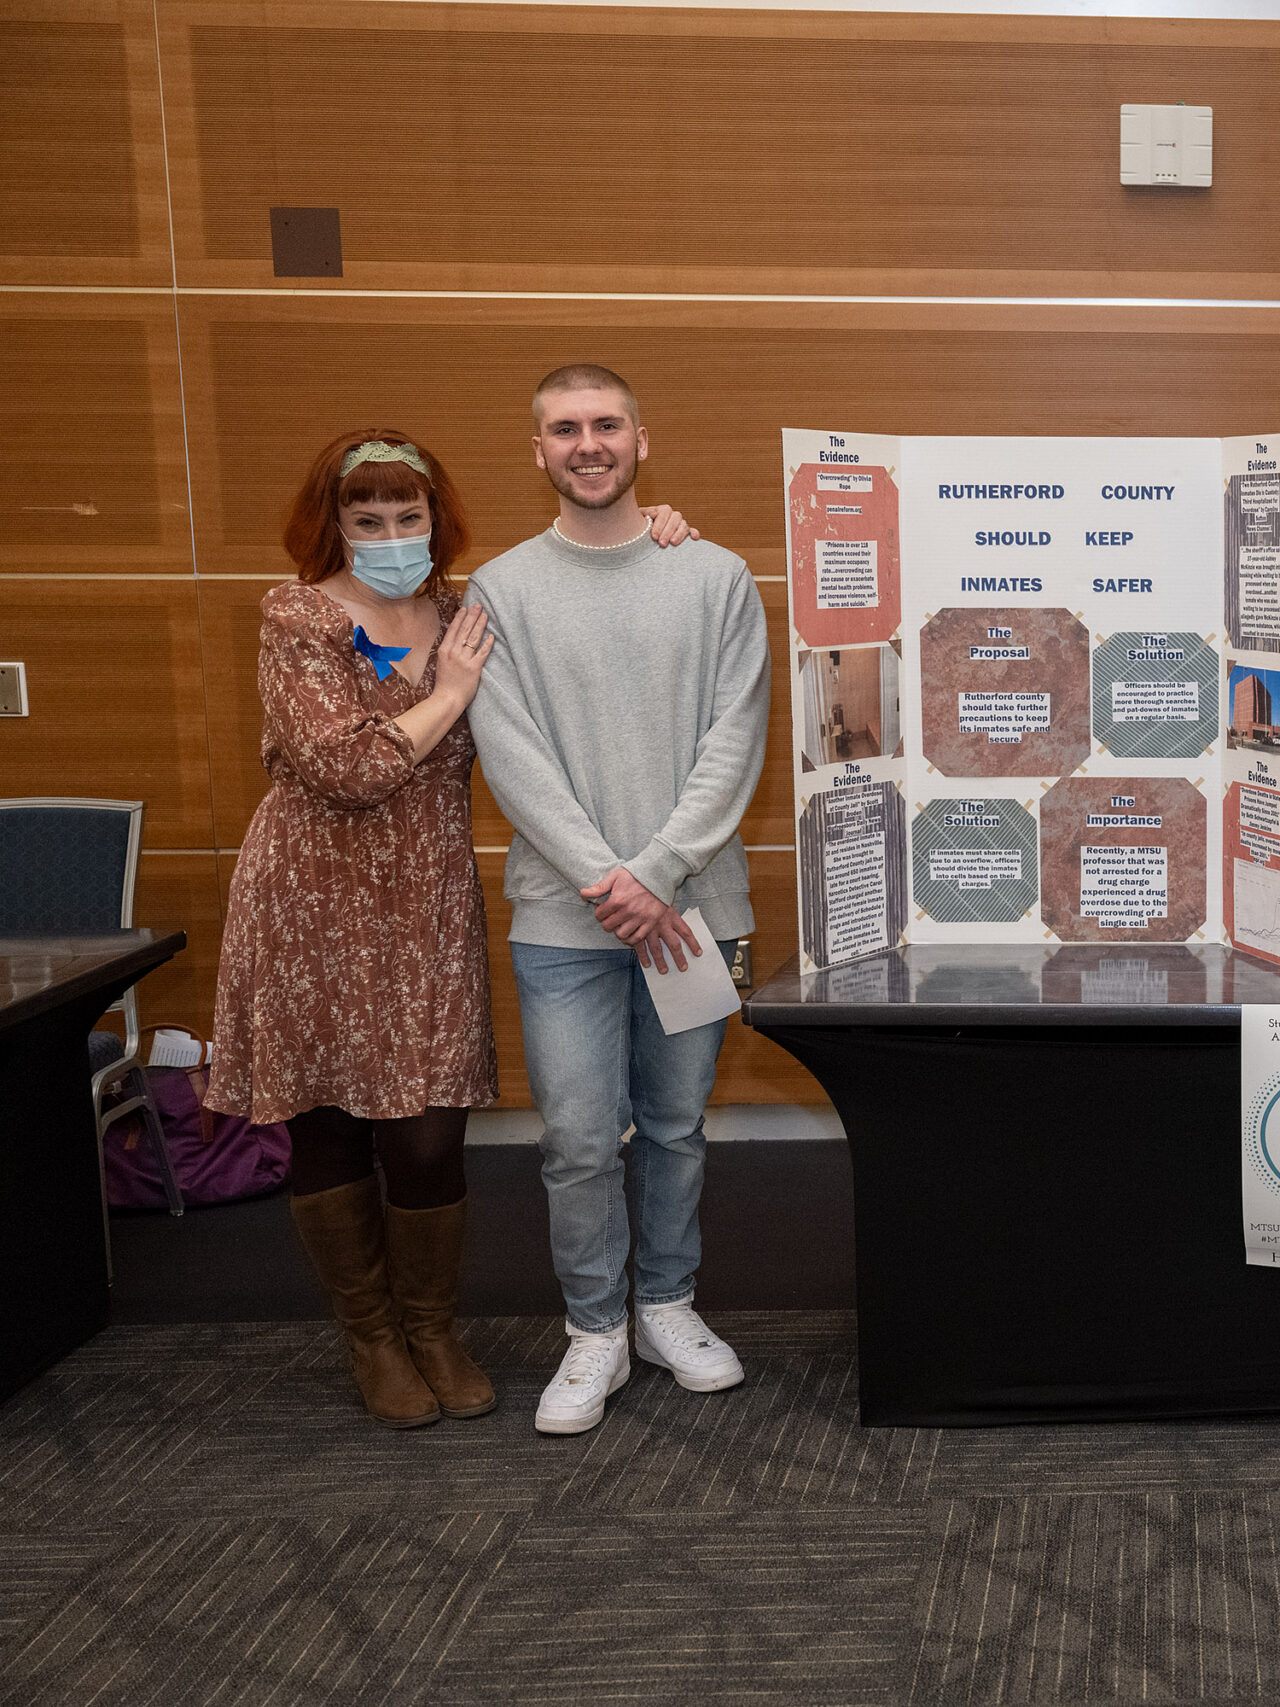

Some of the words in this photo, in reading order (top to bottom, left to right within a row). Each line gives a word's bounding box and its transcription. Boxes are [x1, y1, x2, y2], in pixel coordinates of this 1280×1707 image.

[829, 436, 845, 447] The
[1256, 443, 1267, 454] The
[820, 451, 859, 463] Evidence
[1248, 461, 1276, 471] Evidence
[938, 484, 1065, 500] RUTHERFORD
[1101, 485, 1175, 501] COUNTY
[827, 506, 862, 514] penalreform.org
[975, 531, 1052, 547] SHOULD
[1085, 531, 1134, 546] KEEP
[961, 577, 1043, 592] INMATES
[1092, 578, 1153, 593] SAFER
[988, 628, 1011, 638] The
[1143, 636, 1166, 646] The
[970, 648, 1029, 659] Proposal
[1128, 650, 1183, 659] Solution
[845, 763, 860, 774] The
[1257, 761, 1268, 773] The
[834, 774, 871, 787] Evidence
[1248, 771, 1277, 787] Evidence
[1112, 797, 1135, 806] The
[961, 803, 984, 812] The
[945, 816, 999, 826] Solution
[1087, 815, 1162, 826] Importance
[1083, 858, 1125, 866] professor
[1146, 889, 1166, 897] drug
[1100, 920, 1126, 928] single
